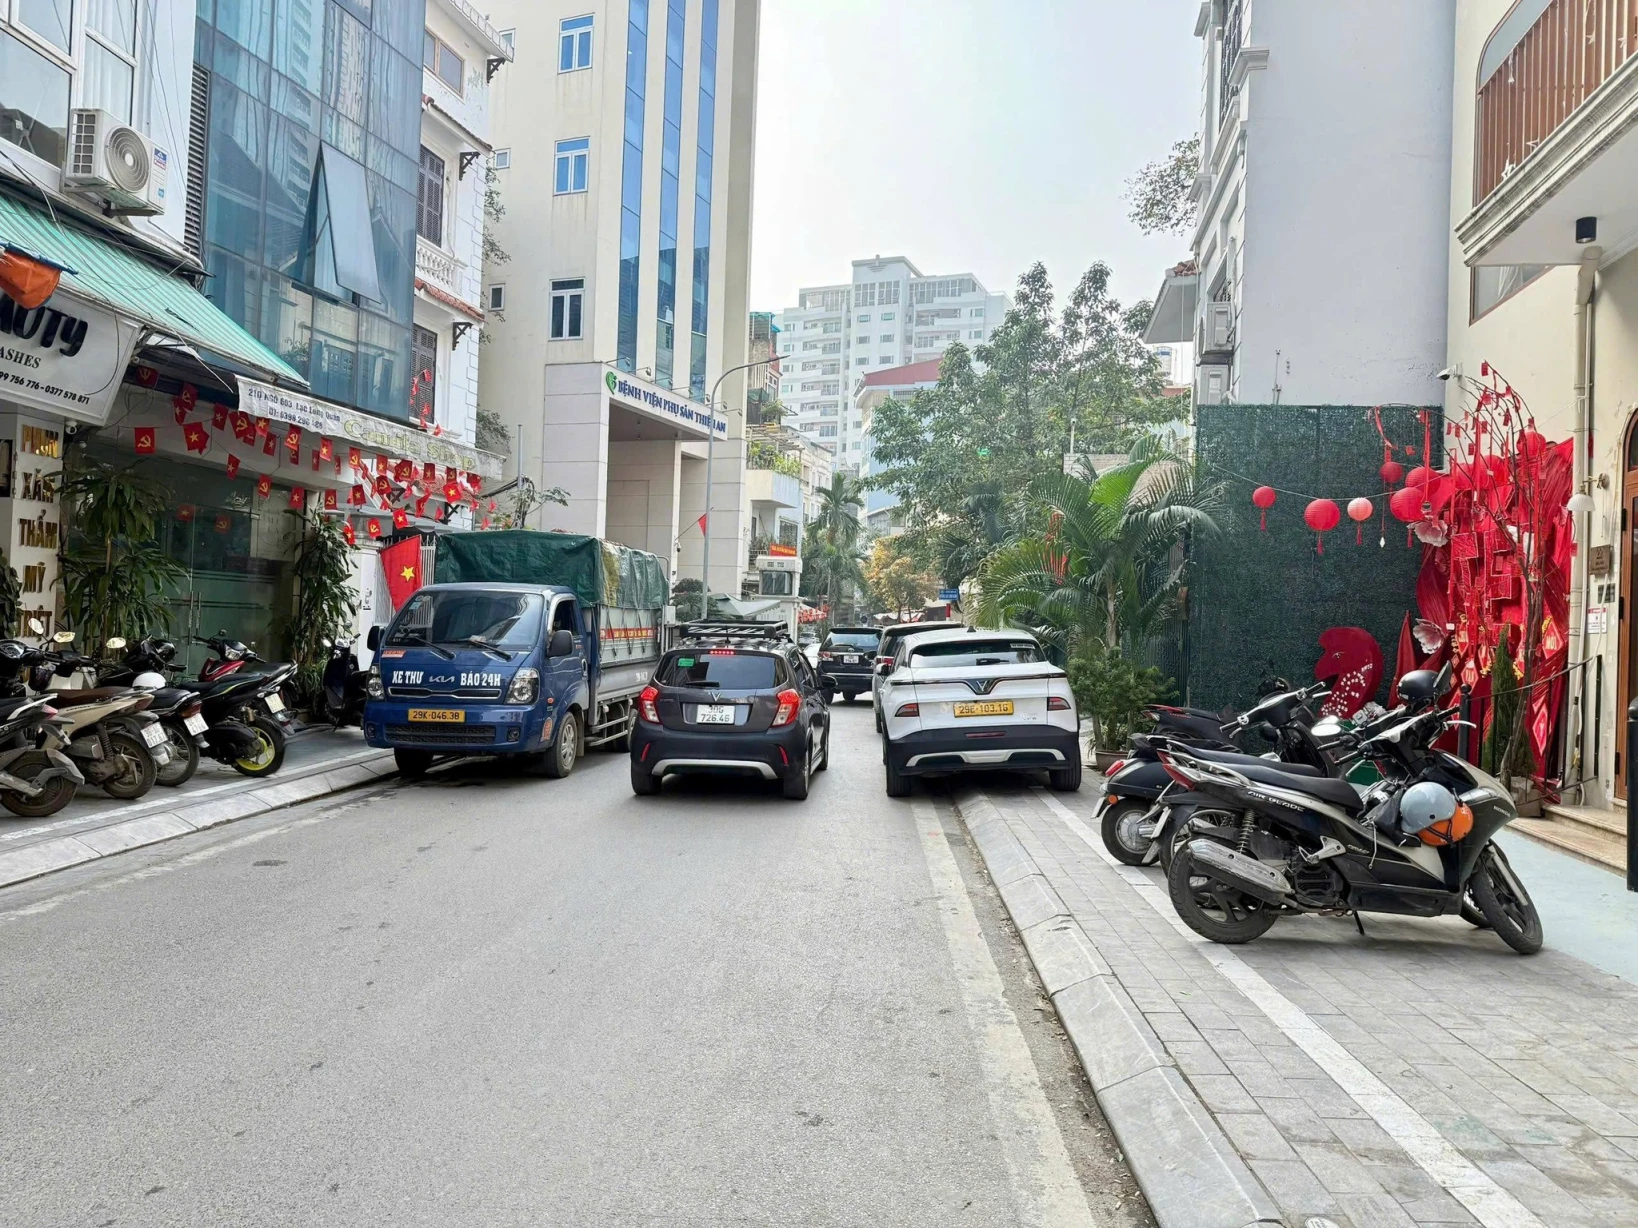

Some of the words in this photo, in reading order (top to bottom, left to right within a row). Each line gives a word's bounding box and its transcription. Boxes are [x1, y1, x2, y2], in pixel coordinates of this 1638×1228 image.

[10, 374, 24, 386] 756
[26, 379, 40, 390] 776
[45, 385, 63, 397] 0377
[63, 390, 76, 401] 578
[77, 394, 90, 405] 871
[279, 397, 293, 408] 603
[309, 405, 324, 418] Long
[618, 379, 641, 401] BỆNH
[643, 390, 662, 408] VIỆN
[663, 398, 679, 417] PHỤ
[716, 419, 726, 433] AN
[426, 441, 476, 470] Shop
[392, 671, 403, 684] XE
[405, 671, 424, 684] THƯ
[460, 670, 480, 686] BÁO
[482, 673, 502, 686] 24H
[1247, 791, 1266, 799] AIR
[1268, 797, 1306, 812] BLADE
